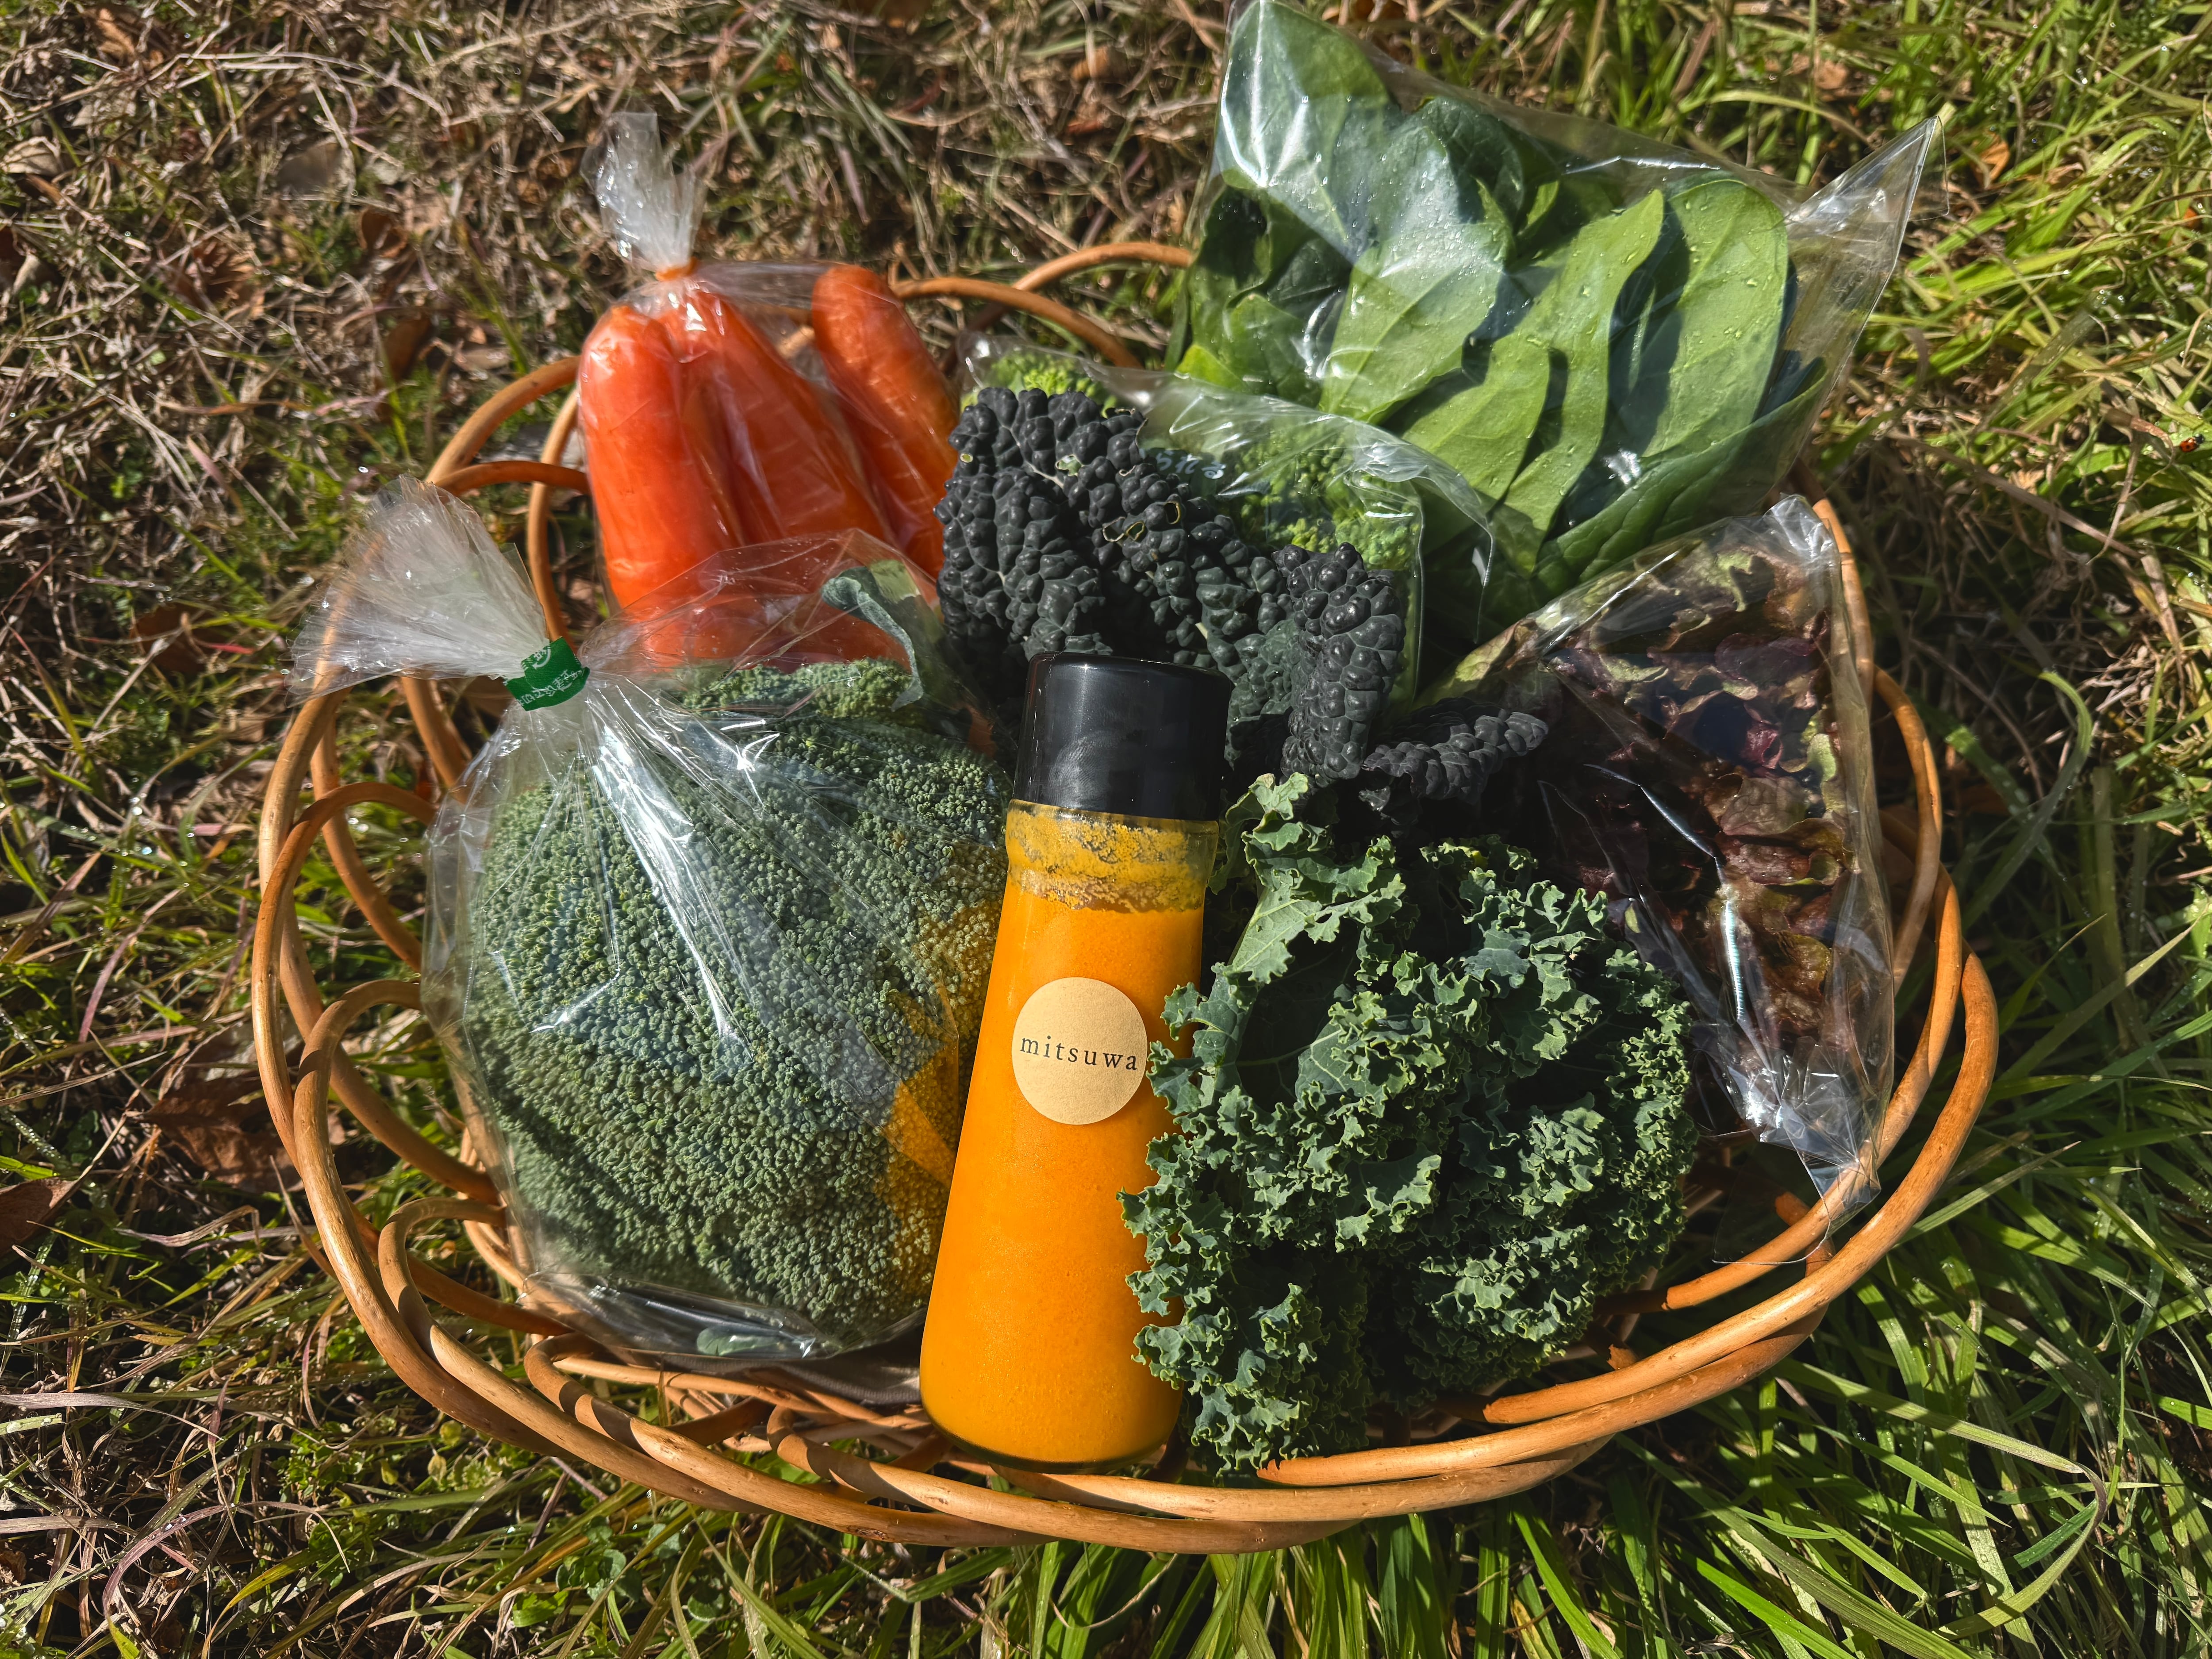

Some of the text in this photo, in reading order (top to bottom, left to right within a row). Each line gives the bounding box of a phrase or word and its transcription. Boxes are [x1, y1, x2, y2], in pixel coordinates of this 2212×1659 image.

[1139, 448, 1226, 479] られる
[1020, 1035, 1137, 1070] mitsuwa
